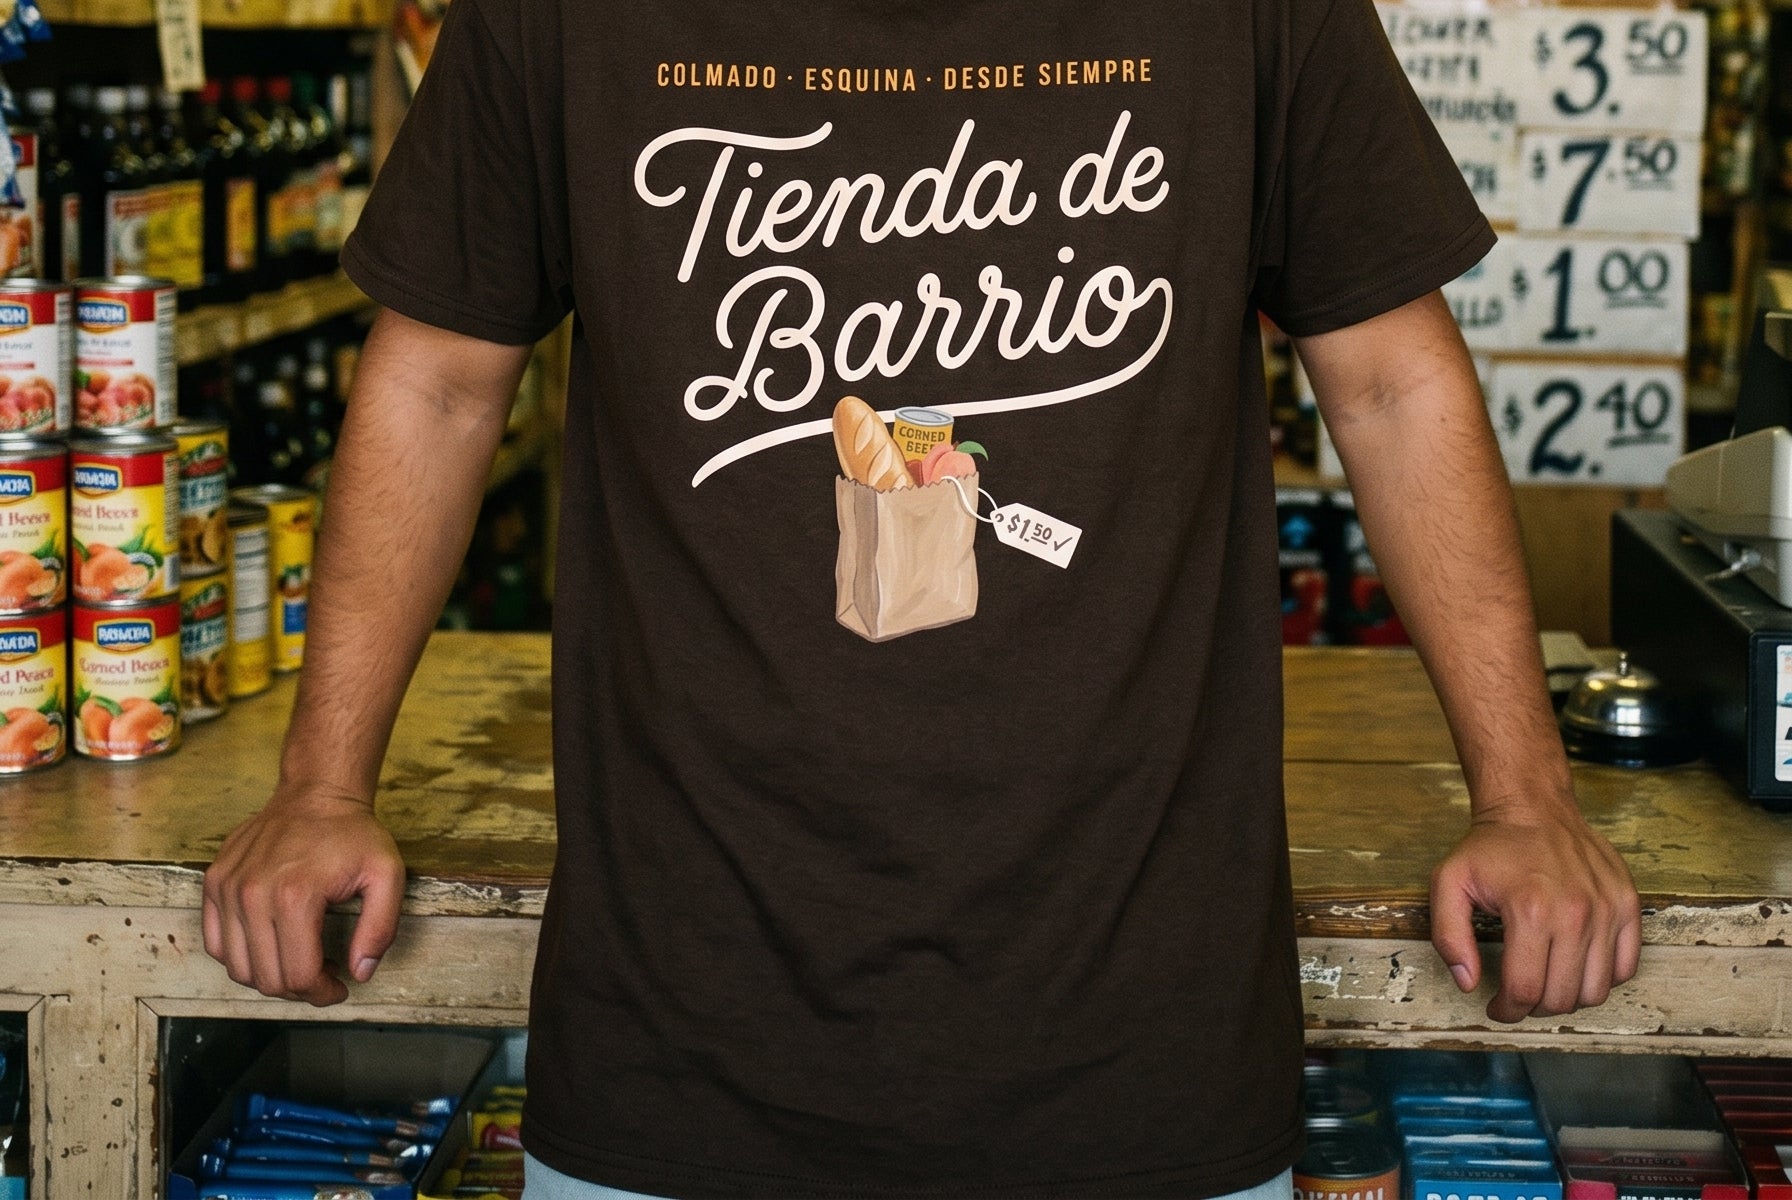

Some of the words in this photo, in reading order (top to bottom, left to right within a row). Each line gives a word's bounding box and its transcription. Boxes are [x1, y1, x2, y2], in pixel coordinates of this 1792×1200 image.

[657, 62, 776, 89] COLMADO
[805, 67, 916, 93] ESQUINA
[944, 64, 1025, 90] DESDE
[1038, 58, 1152, 86] SIEMPRE
[634, 118, 1037, 282] Tienda
[1058, 110, 1170, 218] de
[683, 246, 1173, 421] Barrio
[898, 425, 946, 443] CORNED
[1007, 513, 1053, 545] $1.50
